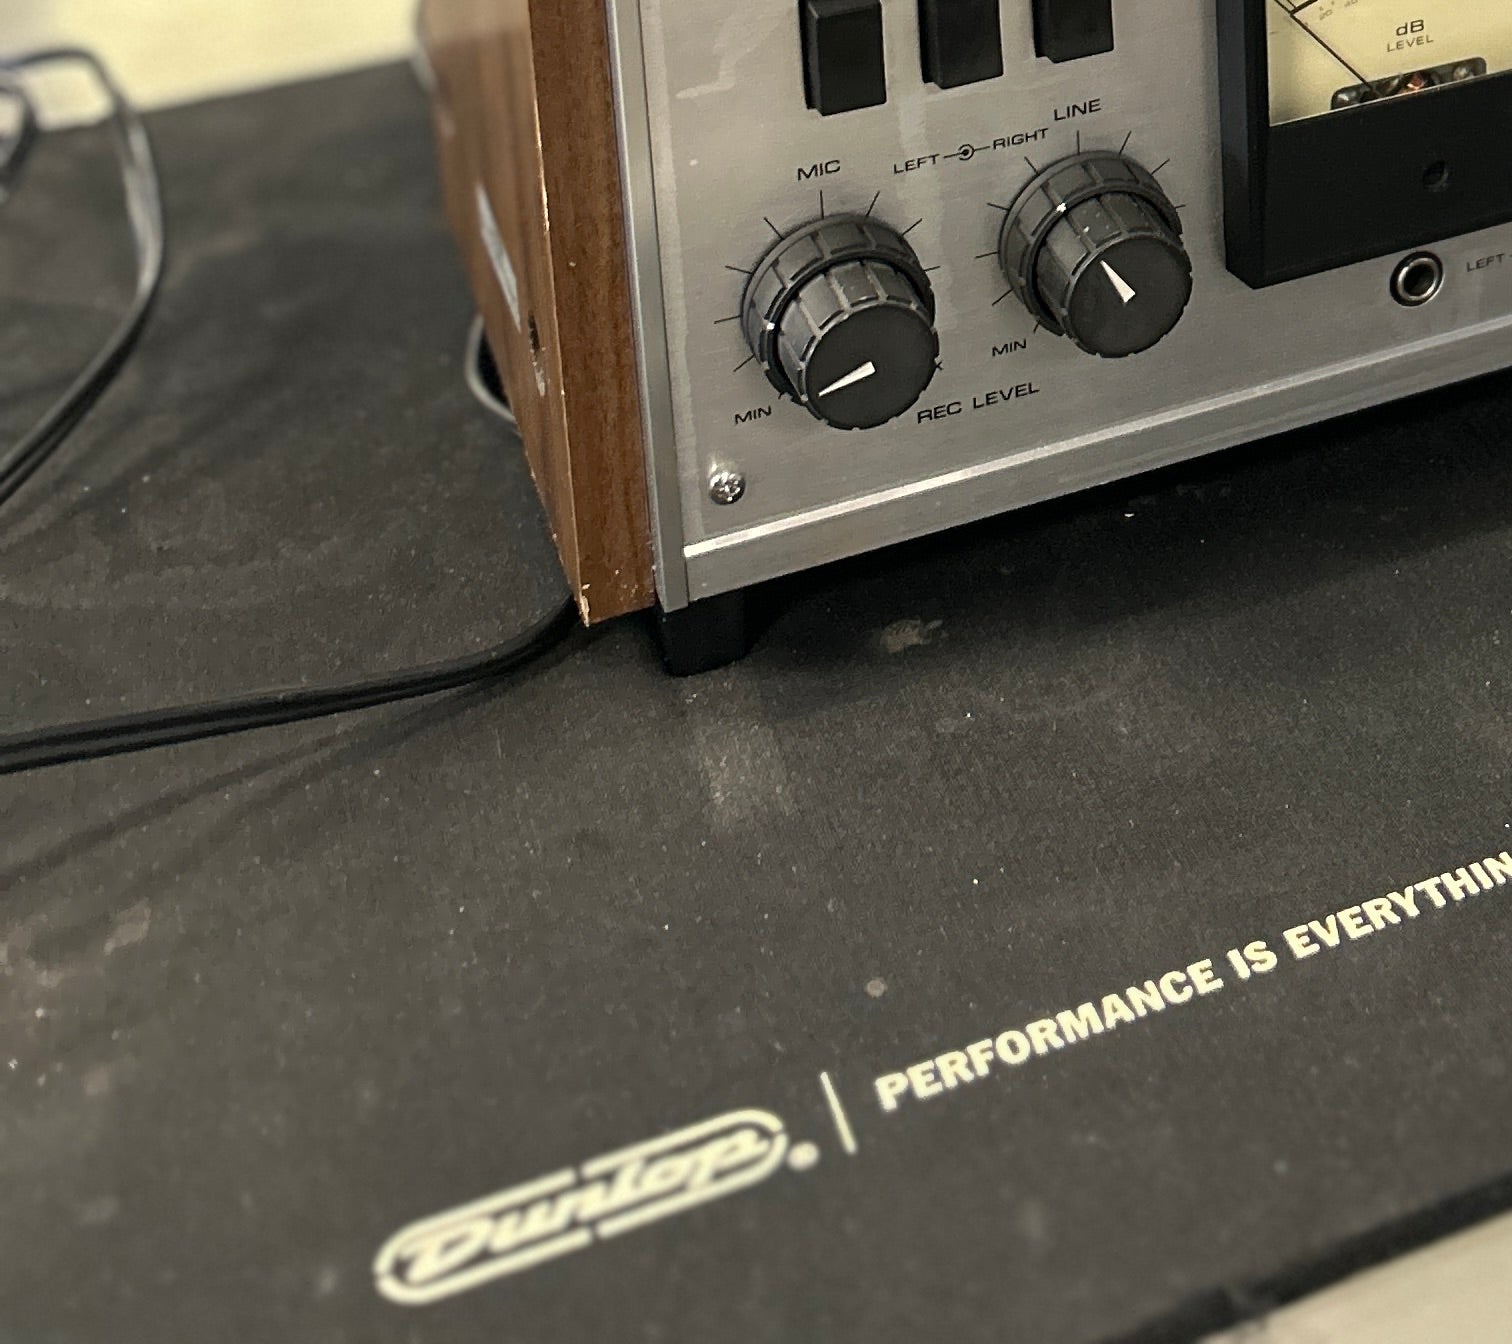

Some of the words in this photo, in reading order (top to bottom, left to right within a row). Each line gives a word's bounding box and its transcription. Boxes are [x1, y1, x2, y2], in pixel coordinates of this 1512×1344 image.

[1396, 19, 1425, 37] dB
[1387, 34, 1434, 53] LEVEL
[1053, 97, 1102, 122] LINE
[893, 152, 941, 175] LEFT
[991, 126, 1049, 150] RIGHT
[797, 158, 841, 181] MIC
[1465, 253, 1506, 274] LEFT
[991, 337, 1028, 358] MIN
[733, 405, 773, 425] MIN
[916, 399, 963, 425] REC
[972, 382, 1041, 410] LEVEL
[874, 958, 1224, 1112] PERFORMANCE
[1226, 939, 1278, 981] IS
[399, 1128, 772, 1284] Dunlop
